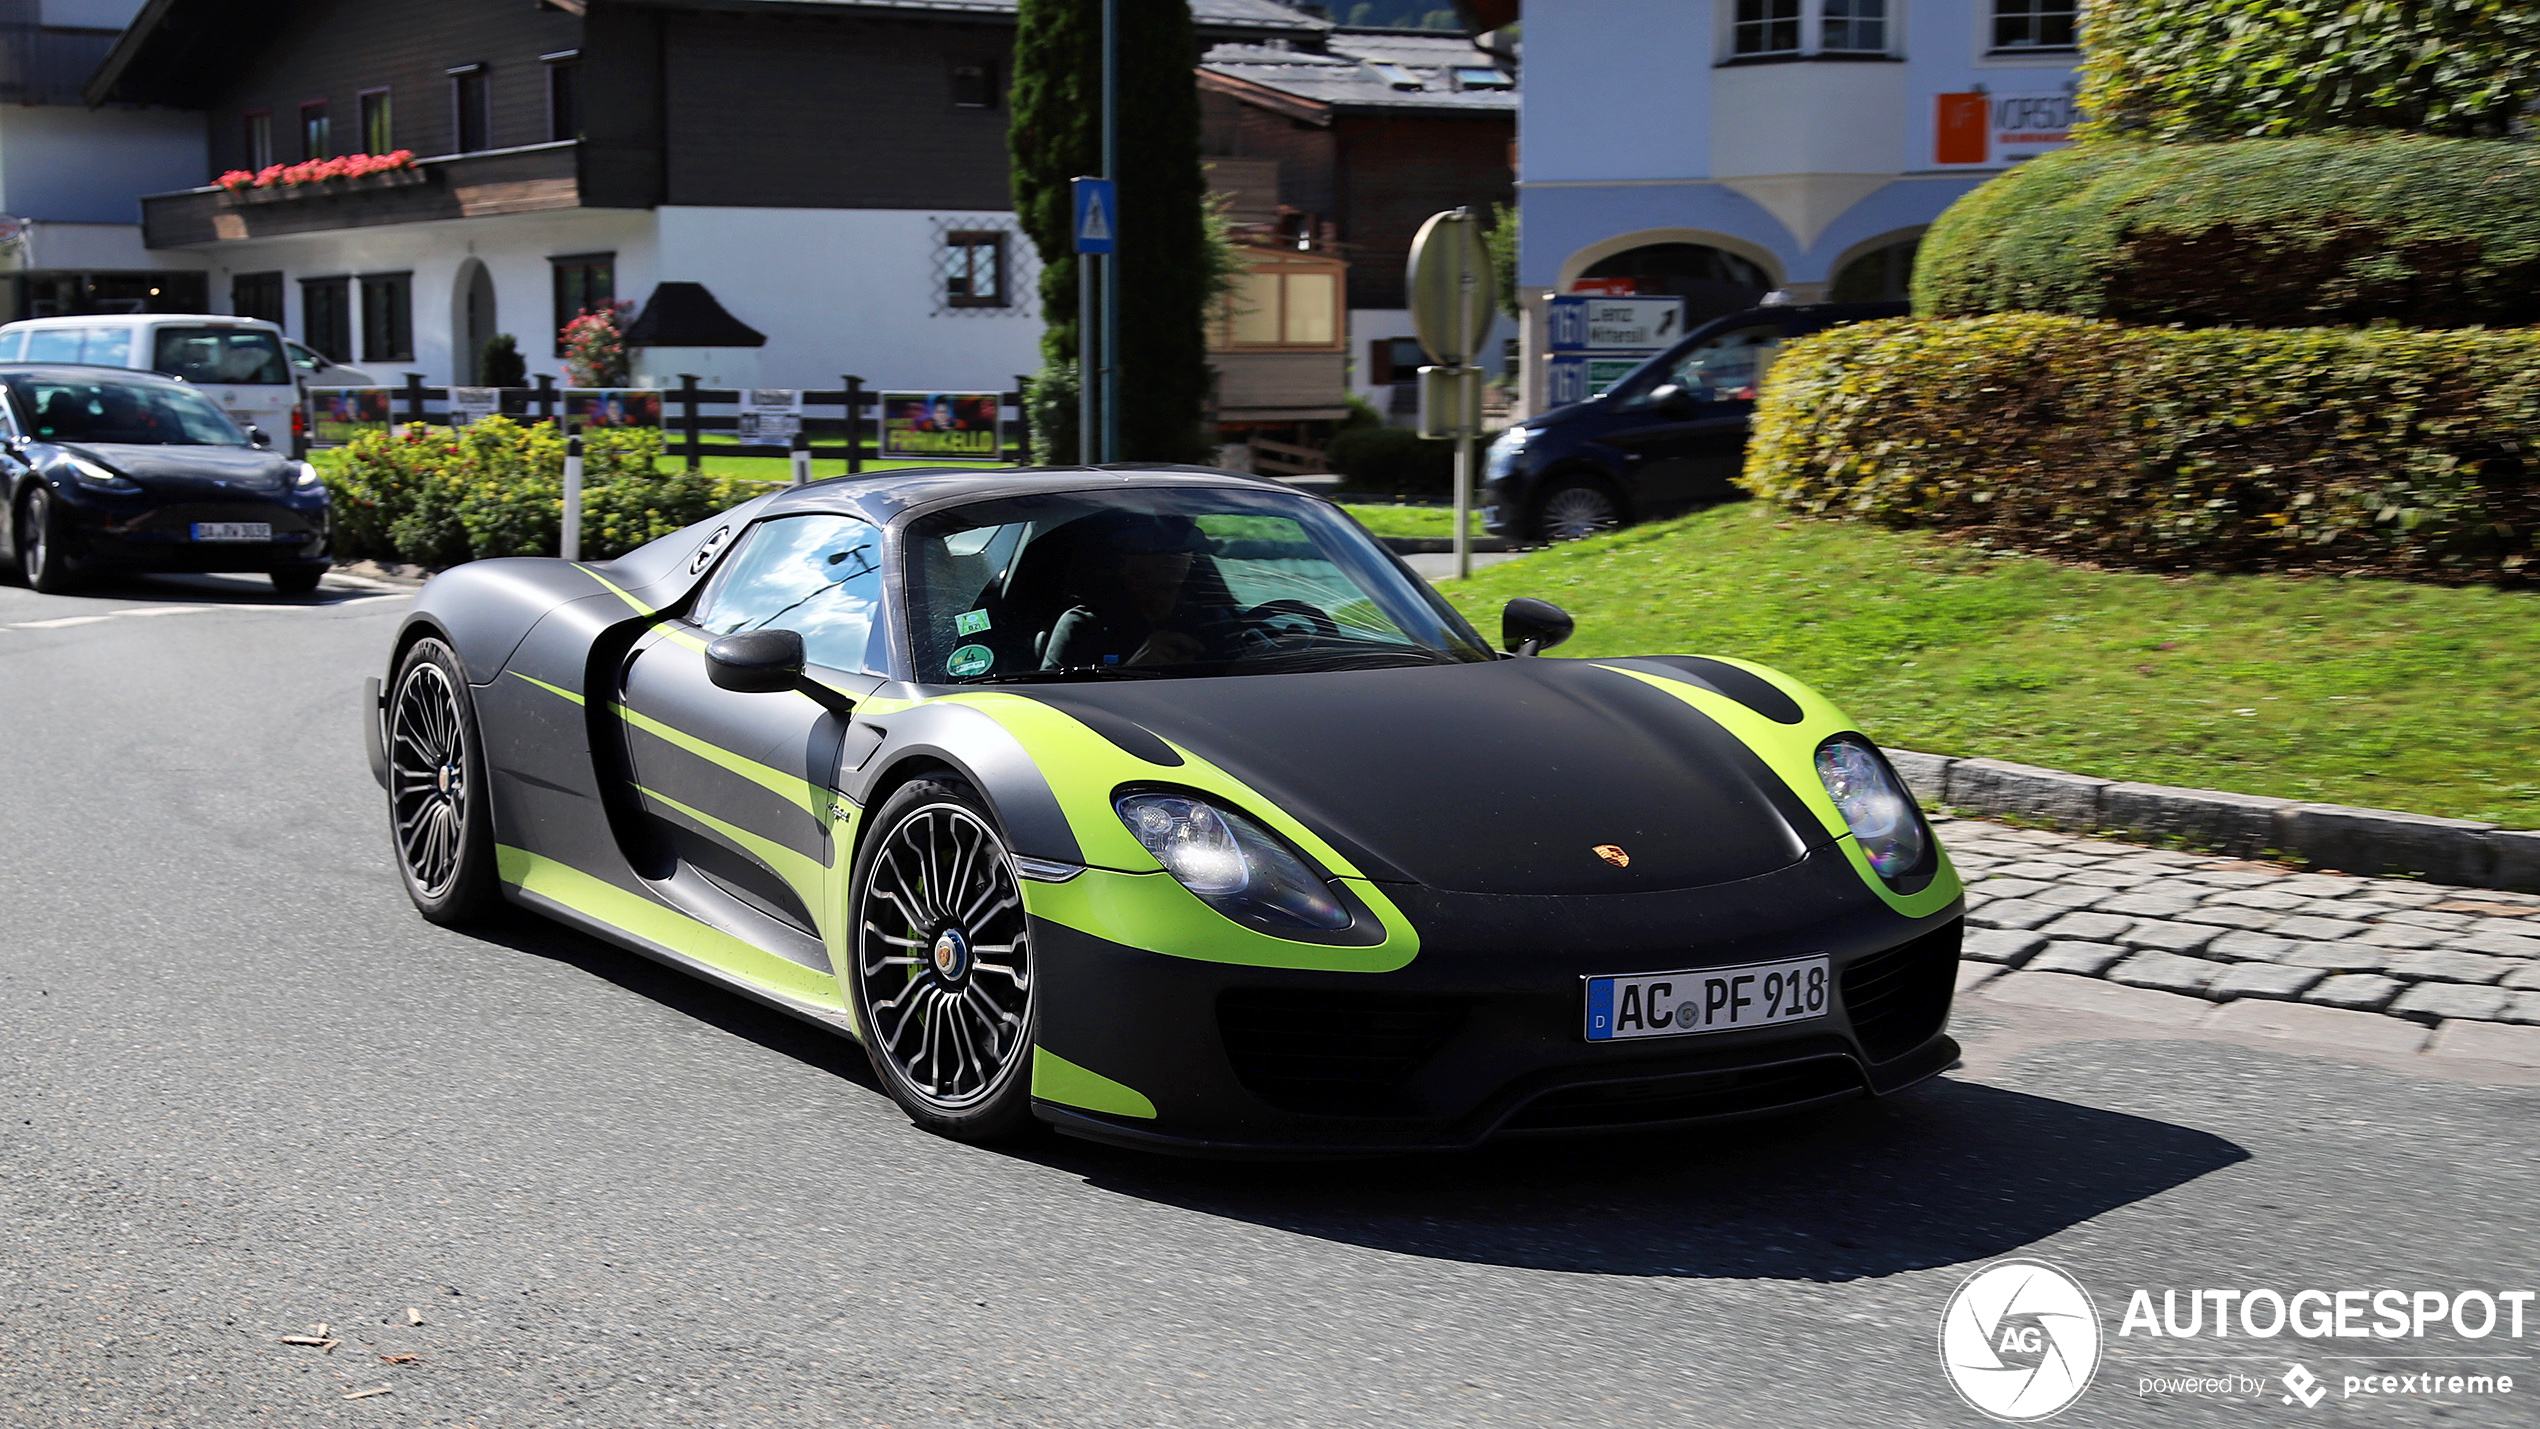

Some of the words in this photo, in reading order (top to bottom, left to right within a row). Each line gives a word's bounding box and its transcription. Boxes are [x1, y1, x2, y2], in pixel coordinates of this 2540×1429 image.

[964, 648, 976, 661] 4
[1616, 983, 1674, 1031] AC
[1704, 974, 1756, 1025] PF
[1763, 966, 1826, 1019] 918
[1595, 1014, 1606, 1029] D
